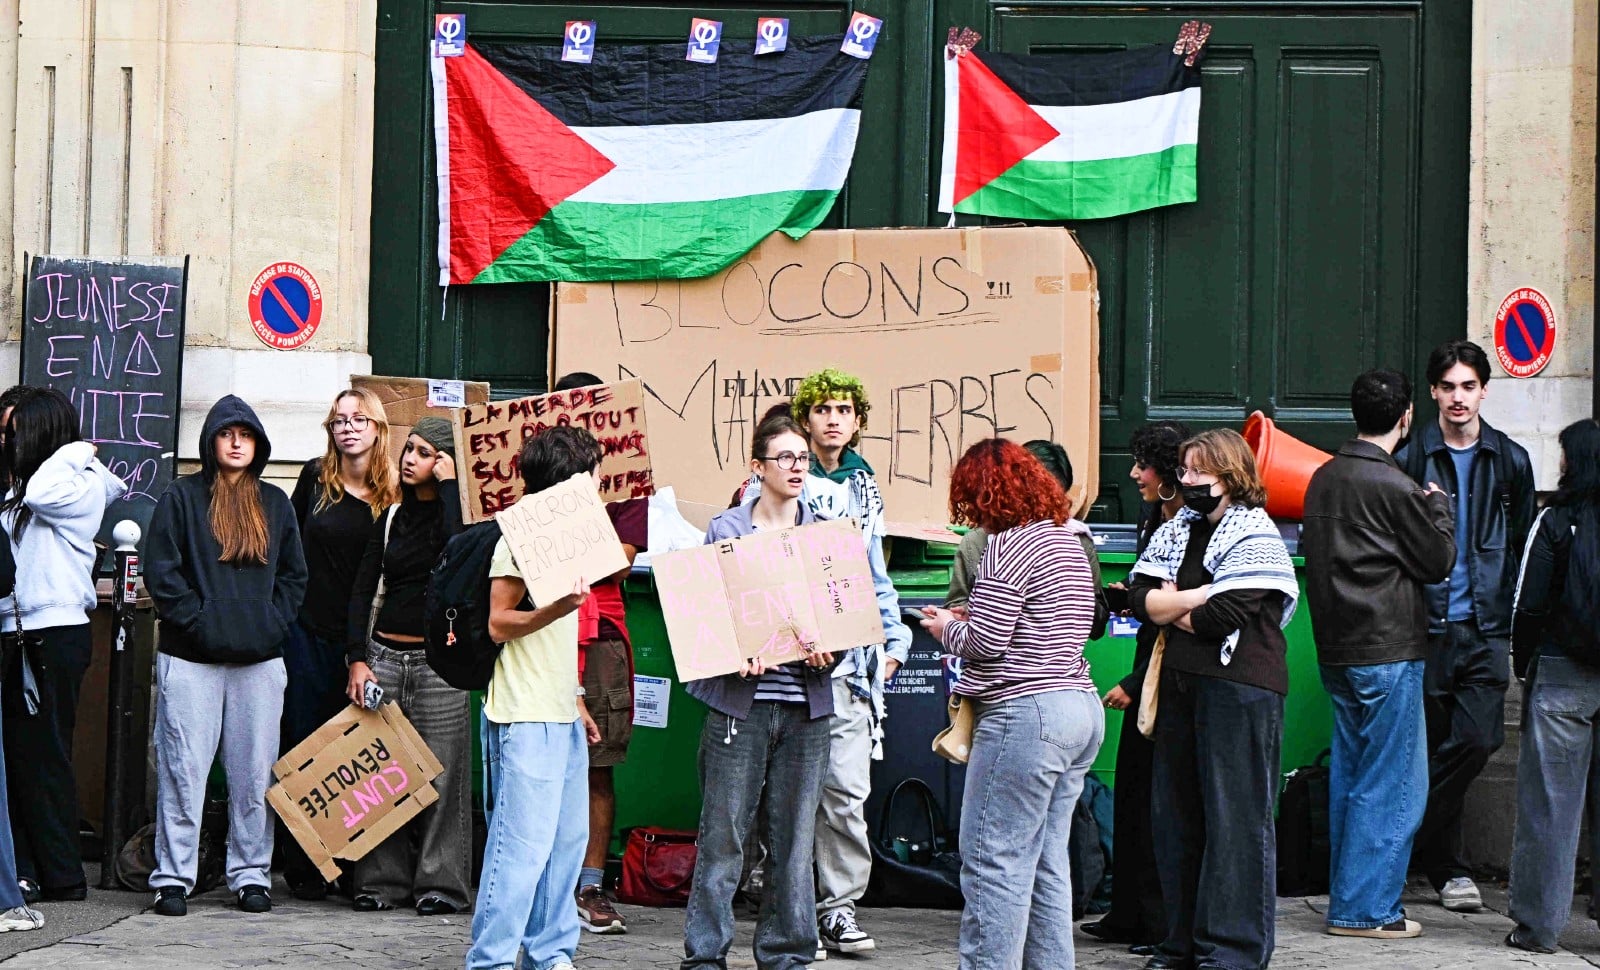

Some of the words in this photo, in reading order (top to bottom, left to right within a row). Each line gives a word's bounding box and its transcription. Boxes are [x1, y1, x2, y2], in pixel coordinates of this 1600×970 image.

[251, 266, 277, 296] DÉFENSE
[277, 264, 287, 273] DE
[287, 265, 321, 300] STATIONNER
[611, 256, 970, 346] BLOCONS
[1519, 290, 1529, 300] DE
[33, 272, 179, 338] JEUNESSE
[254, 319, 276, 343] ACCÈS
[276, 323, 314, 346] POMPIERS
[47, 335, 116, 379] EN
[463, 403, 502, 428] LA
[507, 387, 614, 423] MERDE
[470, 429, 511, 455] EST
[499, 486, 594, 540] MACRON
[518, 518, 616, 582] EXPLOSION
[665, 551, 722, 585] ON
[297, 737, 391, 819] RÉVOLTÉE
